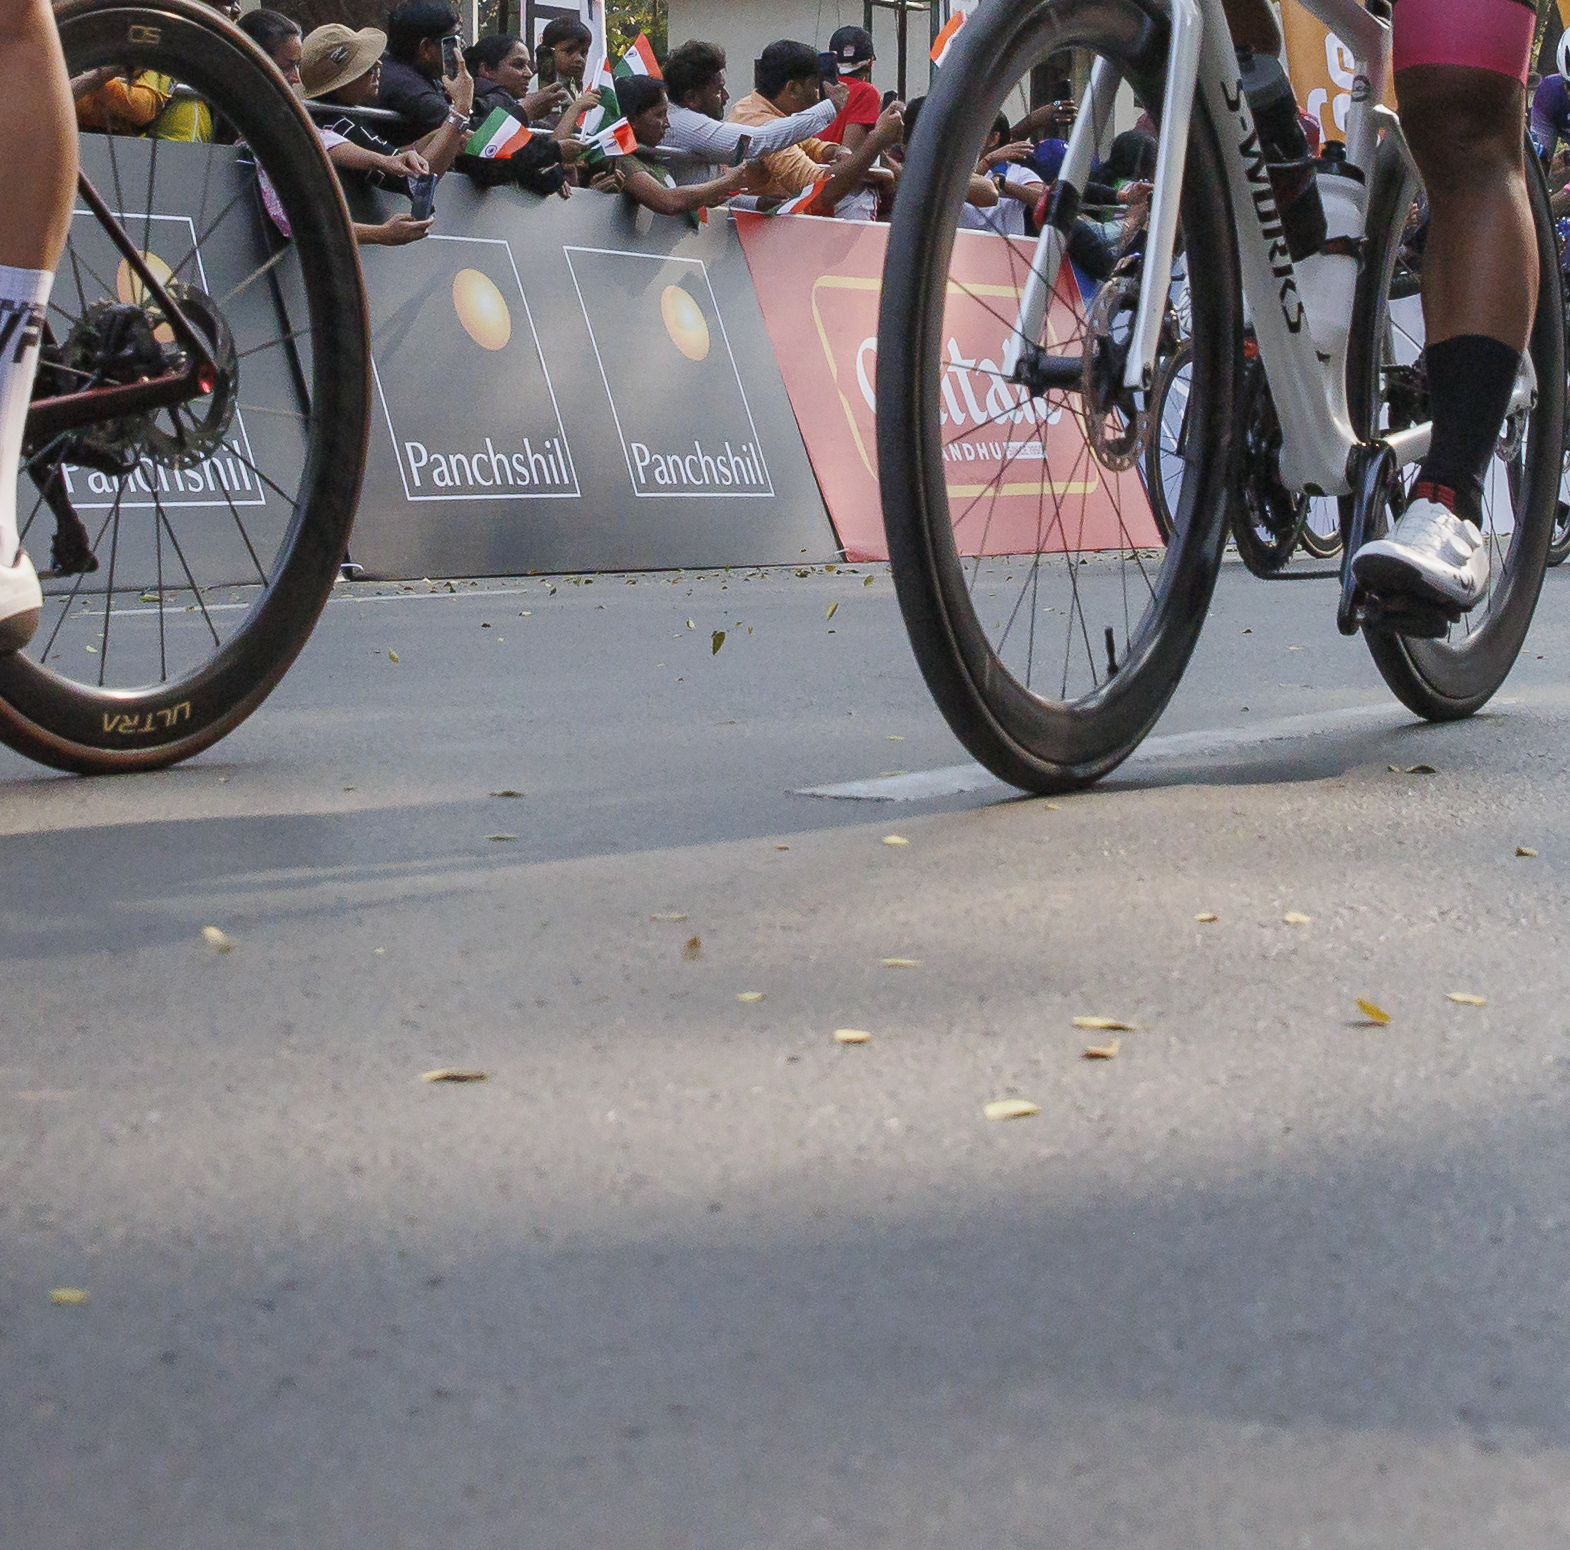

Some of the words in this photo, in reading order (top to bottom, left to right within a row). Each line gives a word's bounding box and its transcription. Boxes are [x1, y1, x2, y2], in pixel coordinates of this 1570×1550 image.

[404, 437, 570, 487] Panchshil
[631, 440, 765, 485] Panchshil
[101, 701, 192, 733] ULTRA
